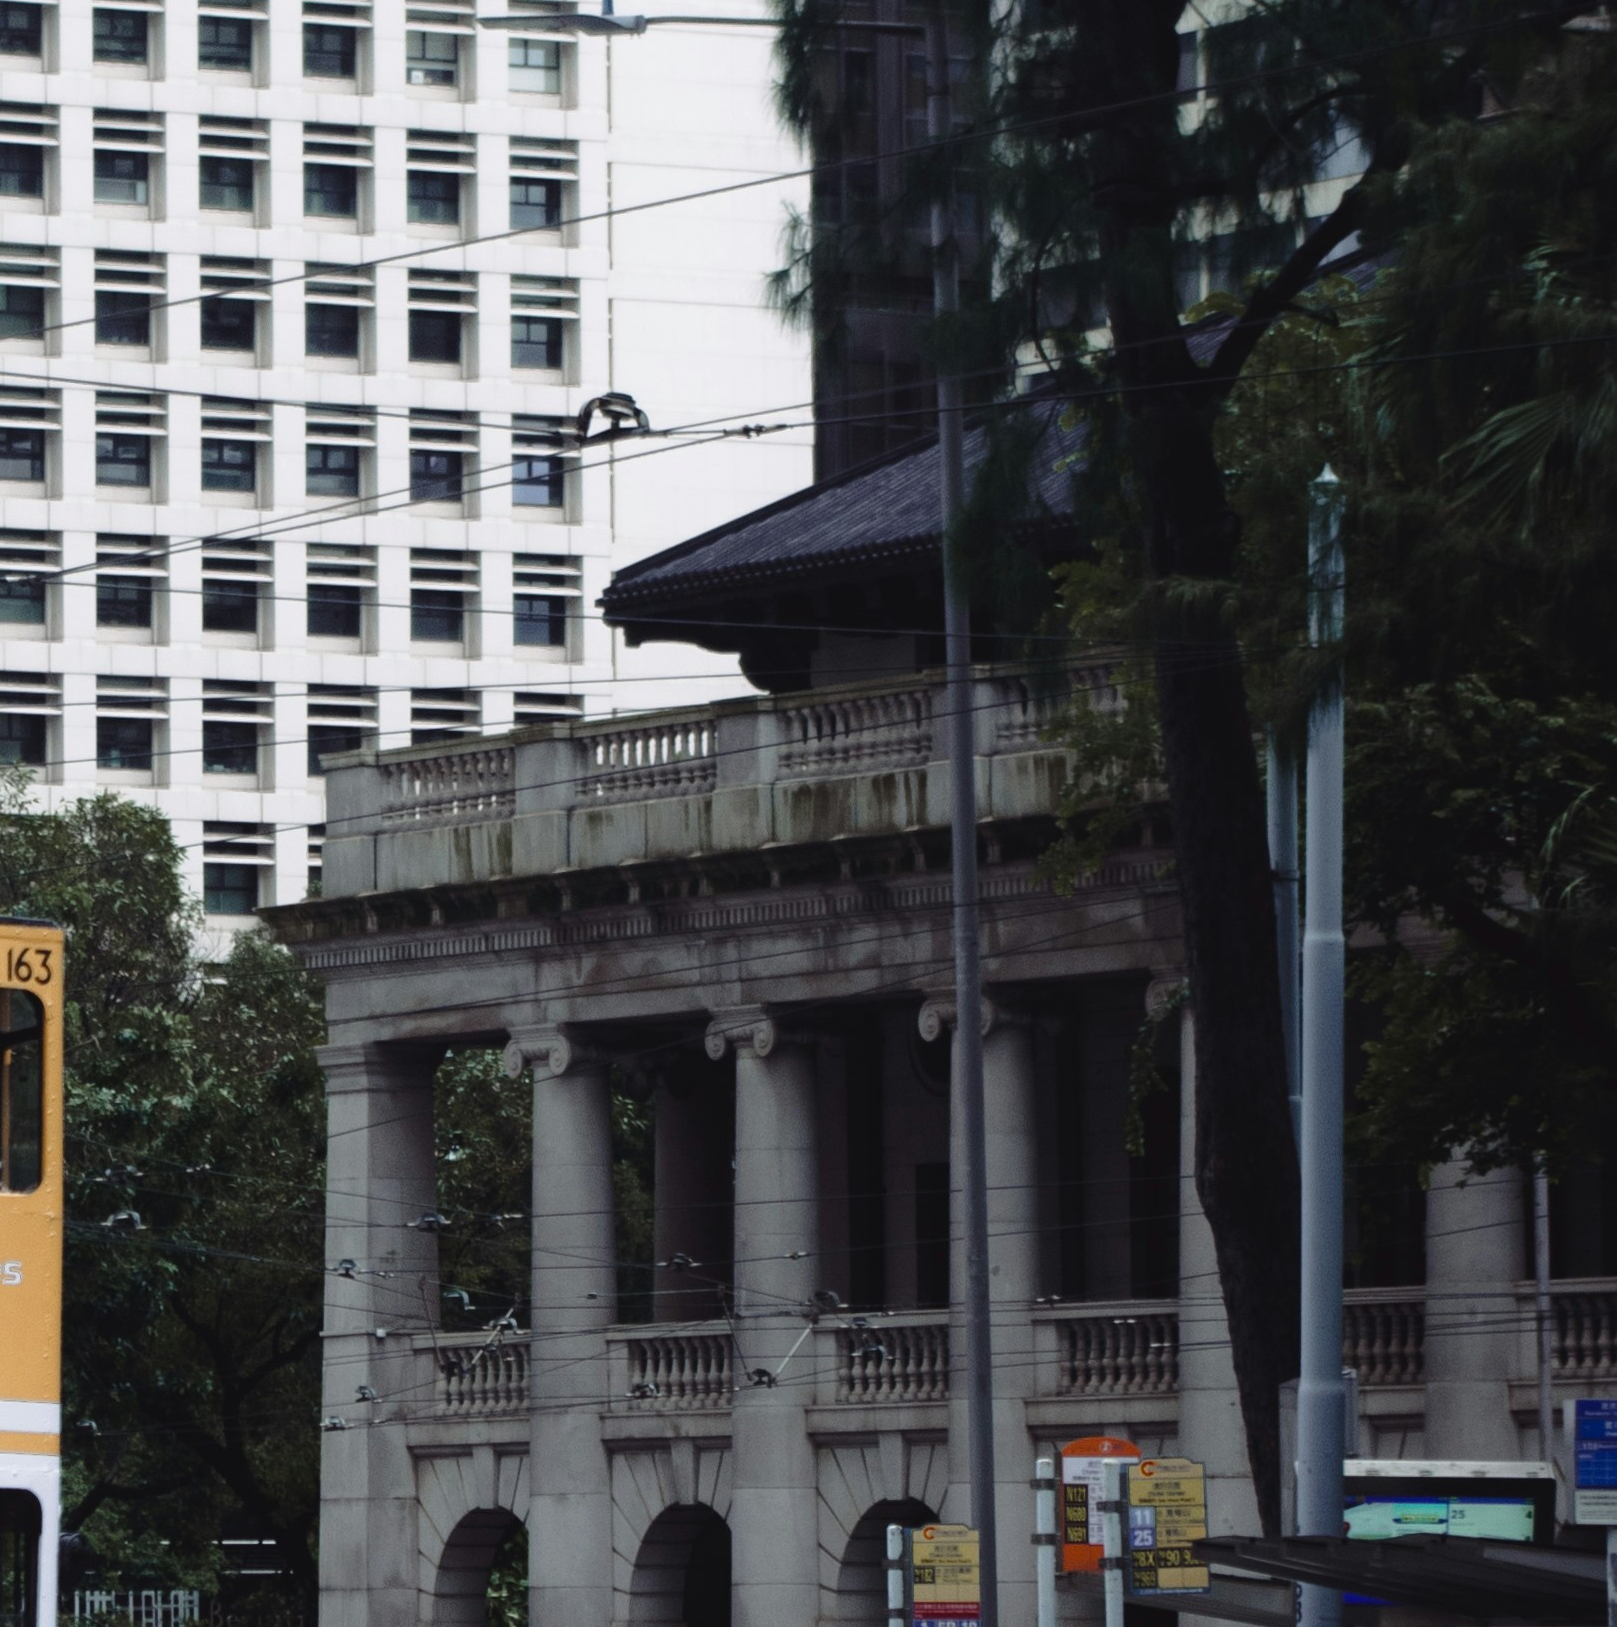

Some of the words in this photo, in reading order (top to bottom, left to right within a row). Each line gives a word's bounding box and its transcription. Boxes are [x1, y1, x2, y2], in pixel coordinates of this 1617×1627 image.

[7, 948, 53, 985] 163
[1134, 1509, 1152, 1526] 11
[1451, 1510, 1466, 1519] 25
[1134, 1529, 1154, 1547] 25
